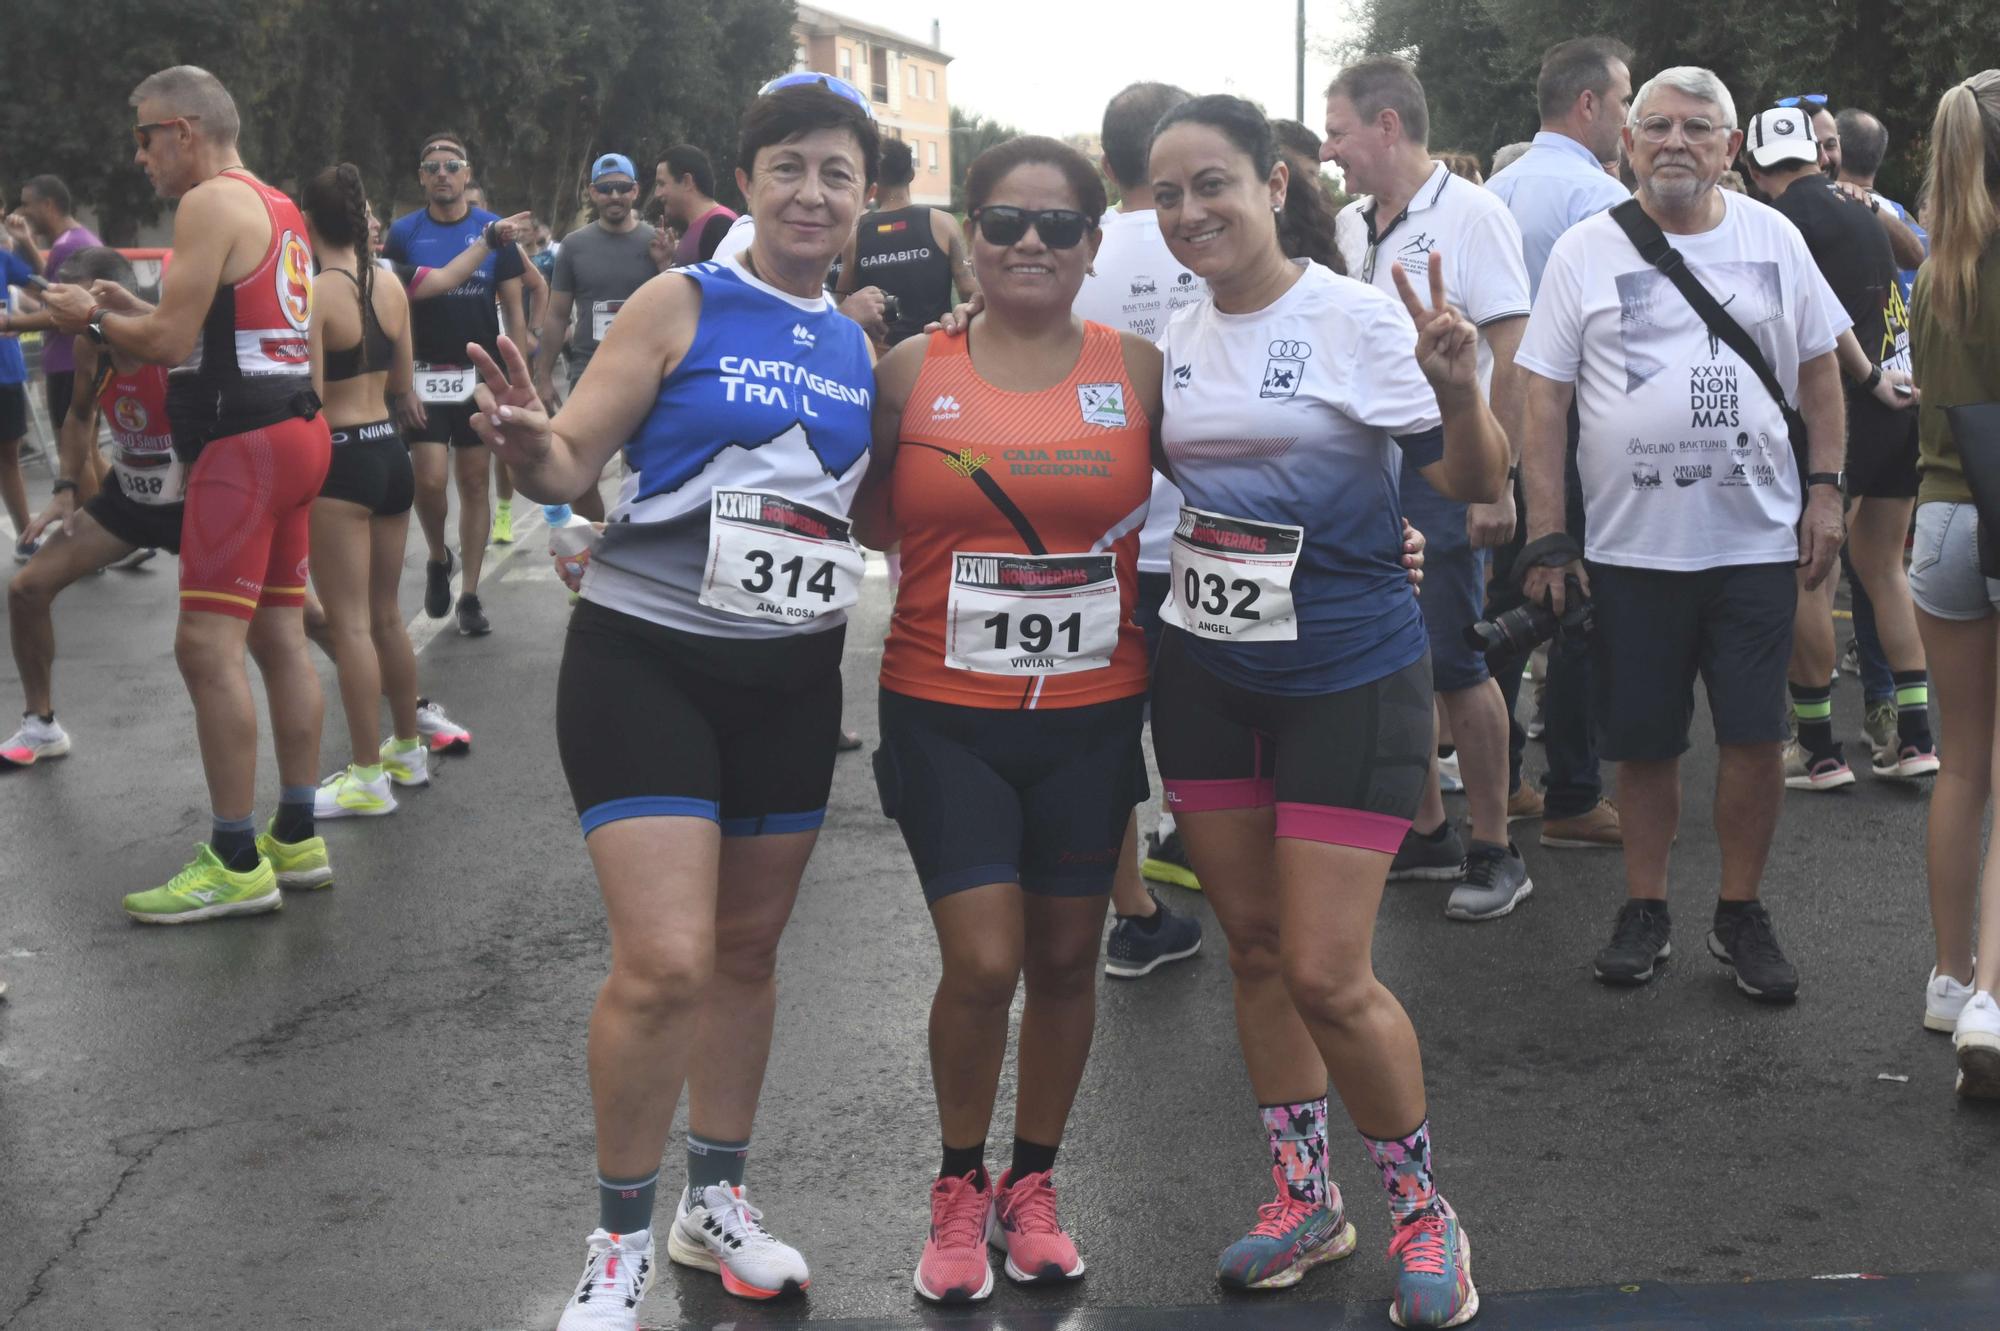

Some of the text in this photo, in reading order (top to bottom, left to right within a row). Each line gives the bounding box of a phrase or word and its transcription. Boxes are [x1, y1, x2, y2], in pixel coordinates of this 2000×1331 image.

[860, 248, 930, 268] GARABITO
[1137, 326, 1155, 335] DAY
[1690, 365, 1736, 378] XXVIII
[425, 378, 464, 393] 536
[719, 356, 870, 412] CARTAGENA
[1691, 378, 1737, 394] NON
[1691, 394, 1739, 410] DUER
[1691, 410, 1739, 428] MAS
[1002, 449, 1049, 462] CAJA
[1009, 464, 1112, 478] REGIONAL
[718, 493, 761, 520] XXVIII
[741, 549, 836, 603] 314
[957, 557, 999, 584] XXVIII
[1001, 567, 1088, 586] NONDUERMAS
[1185, 567, 1261, 620] 032
[756, 602, 815, 619] ANA ROSA
[984, 612, 1081, 653] 191
[1198, 620, 1232, 635] ANGEL
[1011, 658, 1054, 668] VIVIAN
